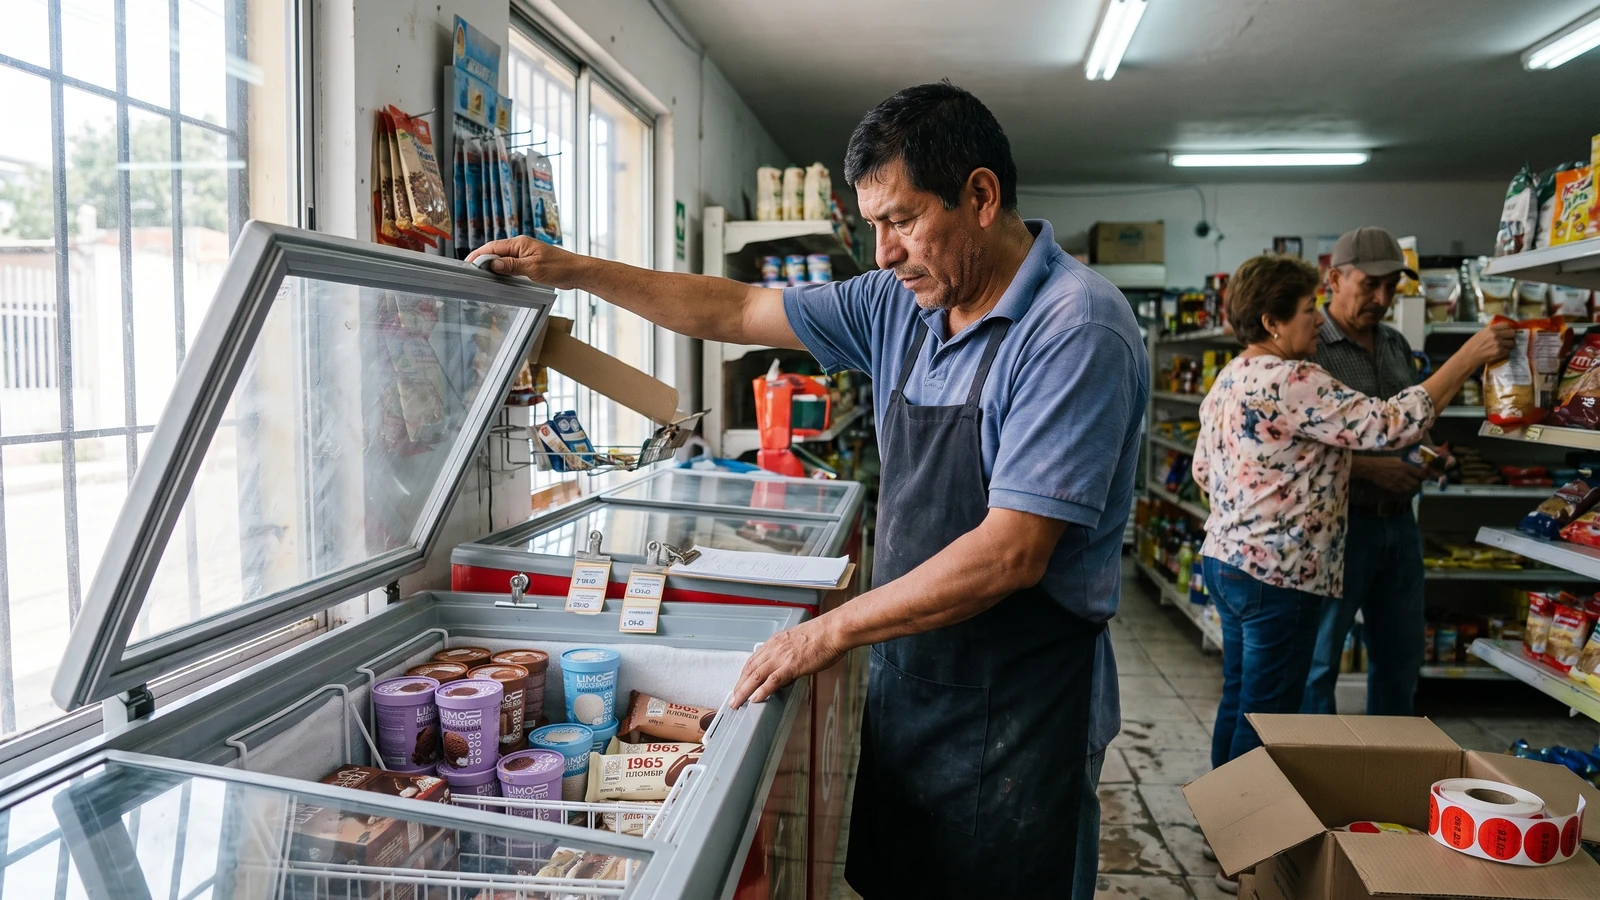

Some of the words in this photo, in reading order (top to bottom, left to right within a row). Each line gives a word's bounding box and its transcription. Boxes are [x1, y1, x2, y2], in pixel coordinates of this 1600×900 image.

[646, 743, 680, 753] 1965
[626, 757, 664, 770] 1965
[625, 770, 664, 778] ПЛОМБІР
